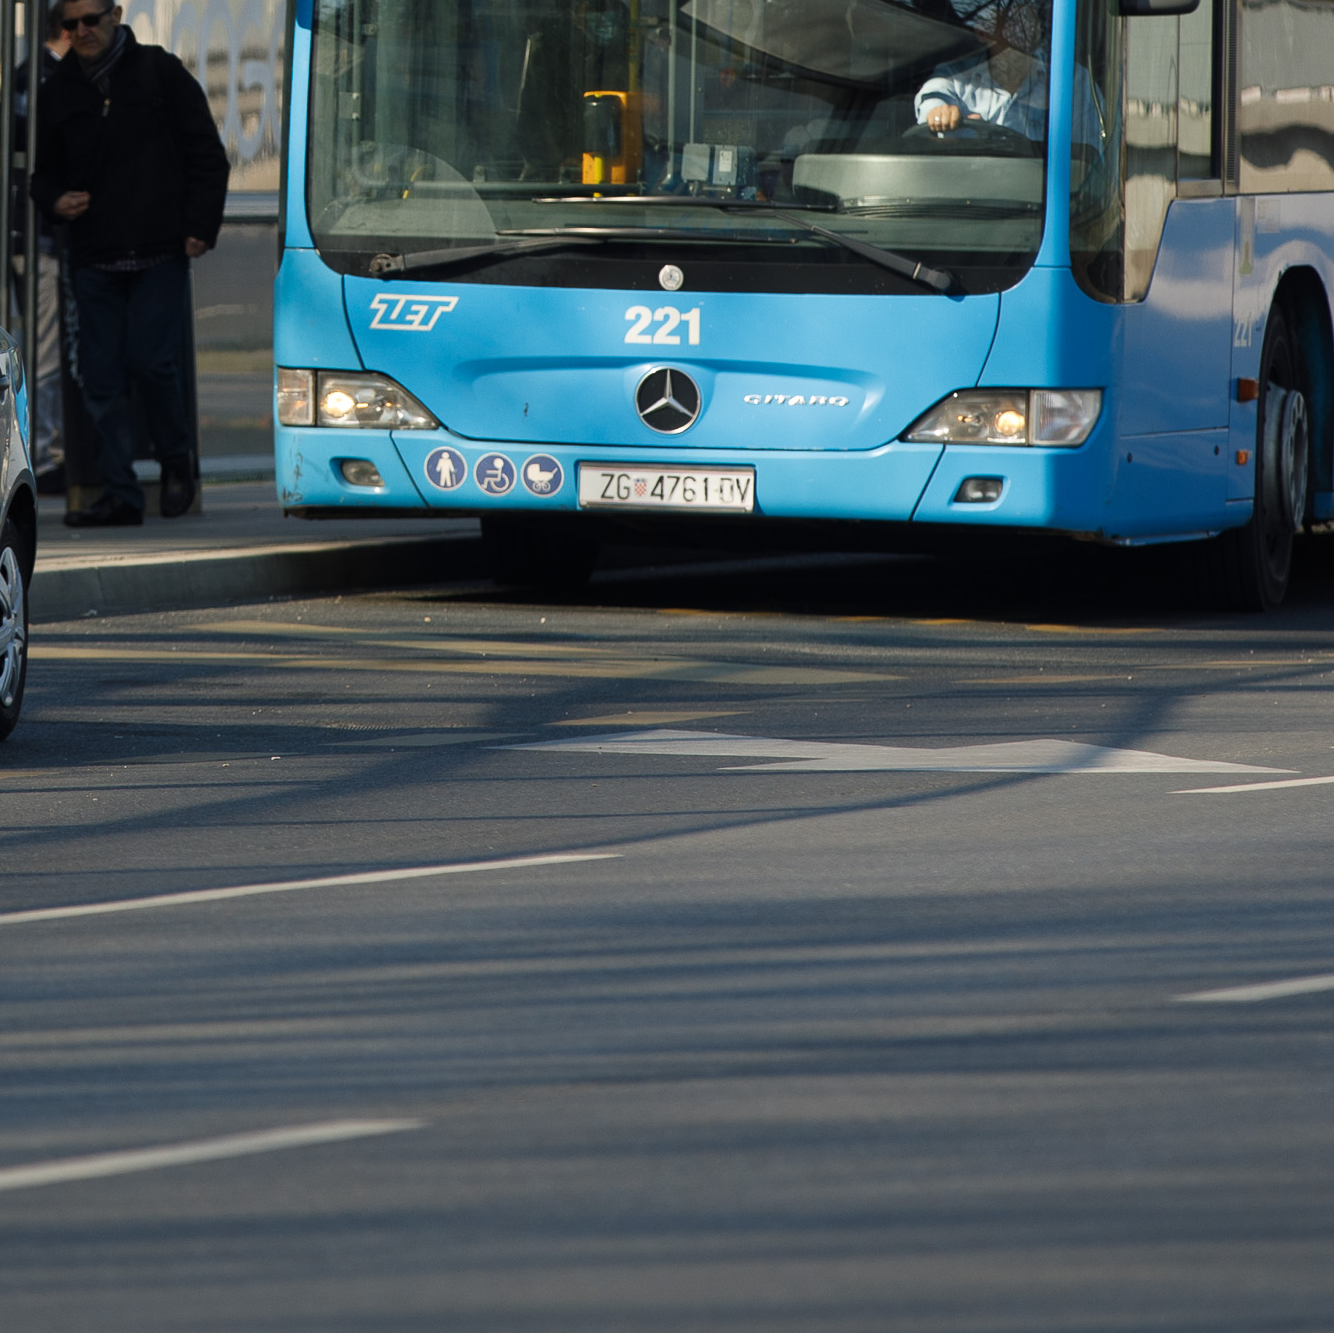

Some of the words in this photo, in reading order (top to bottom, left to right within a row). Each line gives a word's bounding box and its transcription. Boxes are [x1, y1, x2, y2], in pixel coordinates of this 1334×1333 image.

[369, 292, 460, 332] ZET
[624, 304, 701, 345] 221
[1234, 313, 1252, 347] 221
[743, 394, 850, 407] CITARO
[600, 473, 632, 500] ZG
